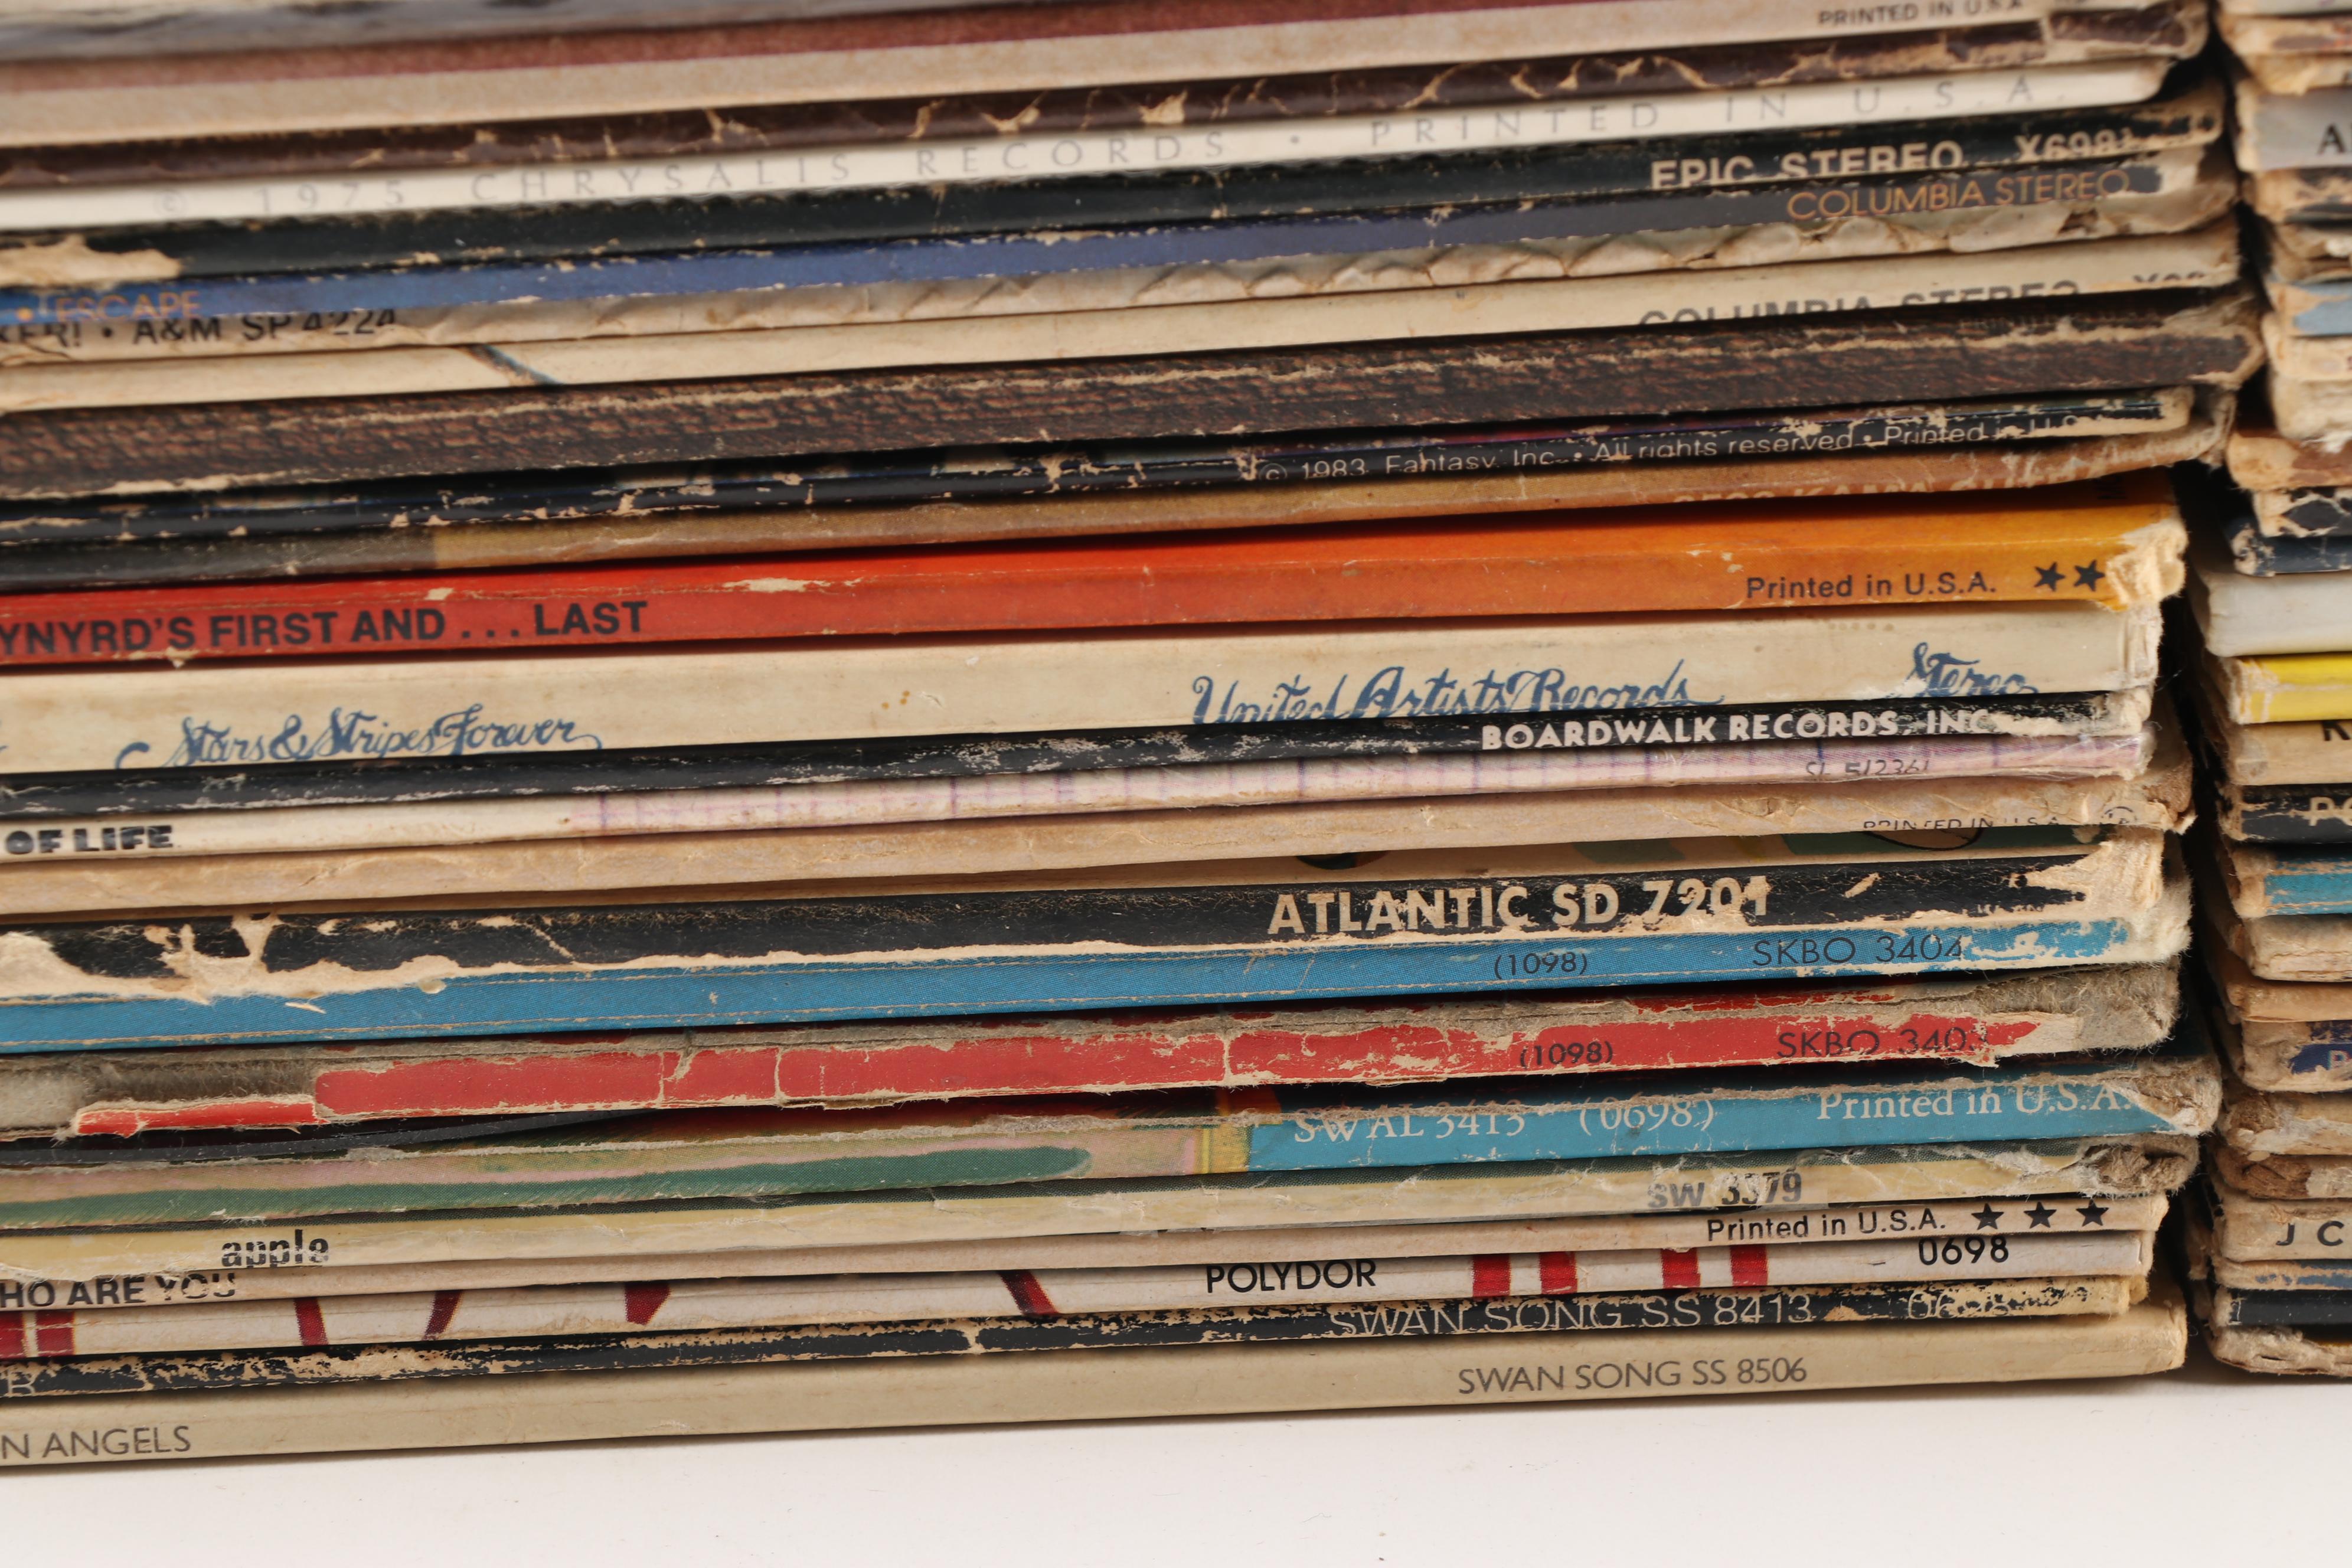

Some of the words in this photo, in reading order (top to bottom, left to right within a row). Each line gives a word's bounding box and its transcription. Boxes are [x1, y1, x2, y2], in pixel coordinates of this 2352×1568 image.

[1818, 4, 1918, 25] PRINTED
[1928, 0, 1953, 17] IN
[253, 178, 405, 215] 1975
[472, 153, 851, 202] CHRYSALIS
[917, 131, 1224, 177] RECORDS
[1371, 102, 1660, 148] PRINTED
[1726, 93, 1788, 122] IN
[1652, 155, 1755, 190] EPIC
[1779, 139, 1966, 178] STEREO
[1786, 179, 1986, 221] COLUMBIA
[1994, 169, 2131, 205] STEREO
[55, 289, 204, 322] ESCAPE
[132, 315, 223, 345] A&M
[241, 313, 292, 341] SP
[1302, 457, 1368, 480] 1983
[1593, 441, 1629, 460] All
[1728, 429, 1854, 455] reserved
[1883, 420, 1985, 445] Printed
[1746, 573, 1853, 599] Printed
[1866, 573, 1893, 596] in
[1904, 570, 1998, 596] U.S.A.
[209, 610, 339, 648] FIRST
[351, 607, 446, 644] AND
[534, 600, 649, 638] LAST
[1192, 674, 1348, 726] United
[1355, 665, 1511, 720] Artists
[1507, 658, 1726, 712] Records
[434, 703, 603, 757] Forever
[1482, 716, 1719, 751] BOARDWALK
[5, 830, 63, 855] OF
[73, 825, 174, 852] LIFE
[1268, 883, 1530, 935] ATLANTIC
[1551, 881, 1619, 926] SD
[1641, 876, 1771, 919] 7201
[1494, 950, 1587, 981] (1098)
[1752, 936, 1857, 967] SKBO
[1875, 933, 1963, 962] 3404
[1520, 1040, 1615, 1070] (1098)
[1776, 1029, 1880, 1059] SKBO
[1435, 1099, 1526, 1139] 3413
[1580, 1095, 1714, 1136] (0698)
[1816, 1085, 1955, 1120] Printed
[1966, 1087, 2003, 1115] in
[1647, 1182, 1705, 1208] SW
[1707, 1214, 1809, 1241] Printed
[1821, 1213, 1846, 1236] in
[1857, 1208, 1947, 1234] U.S.A.
[221, 1229, 330, 1268] apple
[1918, 1237, 2010, 1265] 0698
[67, 1276, 145, 1305] ARE
[156, 1273, 236, 1302] YOU
[1206, 1259, 1377, 1293] POLYDOR
[1329, 1302, 1465, 1335] SWAN
[1484, 1301, 1623, 1333] SONG
[1641, 1296, 1700, 1328] SS
[1713, 1293, 1812, 1325] 8413
[1458, 1364, 1566, 1396] SWAN
[1574, 1360, 1683, 1390] SONG
[1691, 1359, 1727, 1386] SS
[1737, 1357, 1808, 1385] 8506
[41, 1425, 192, 1460] ANGELS
